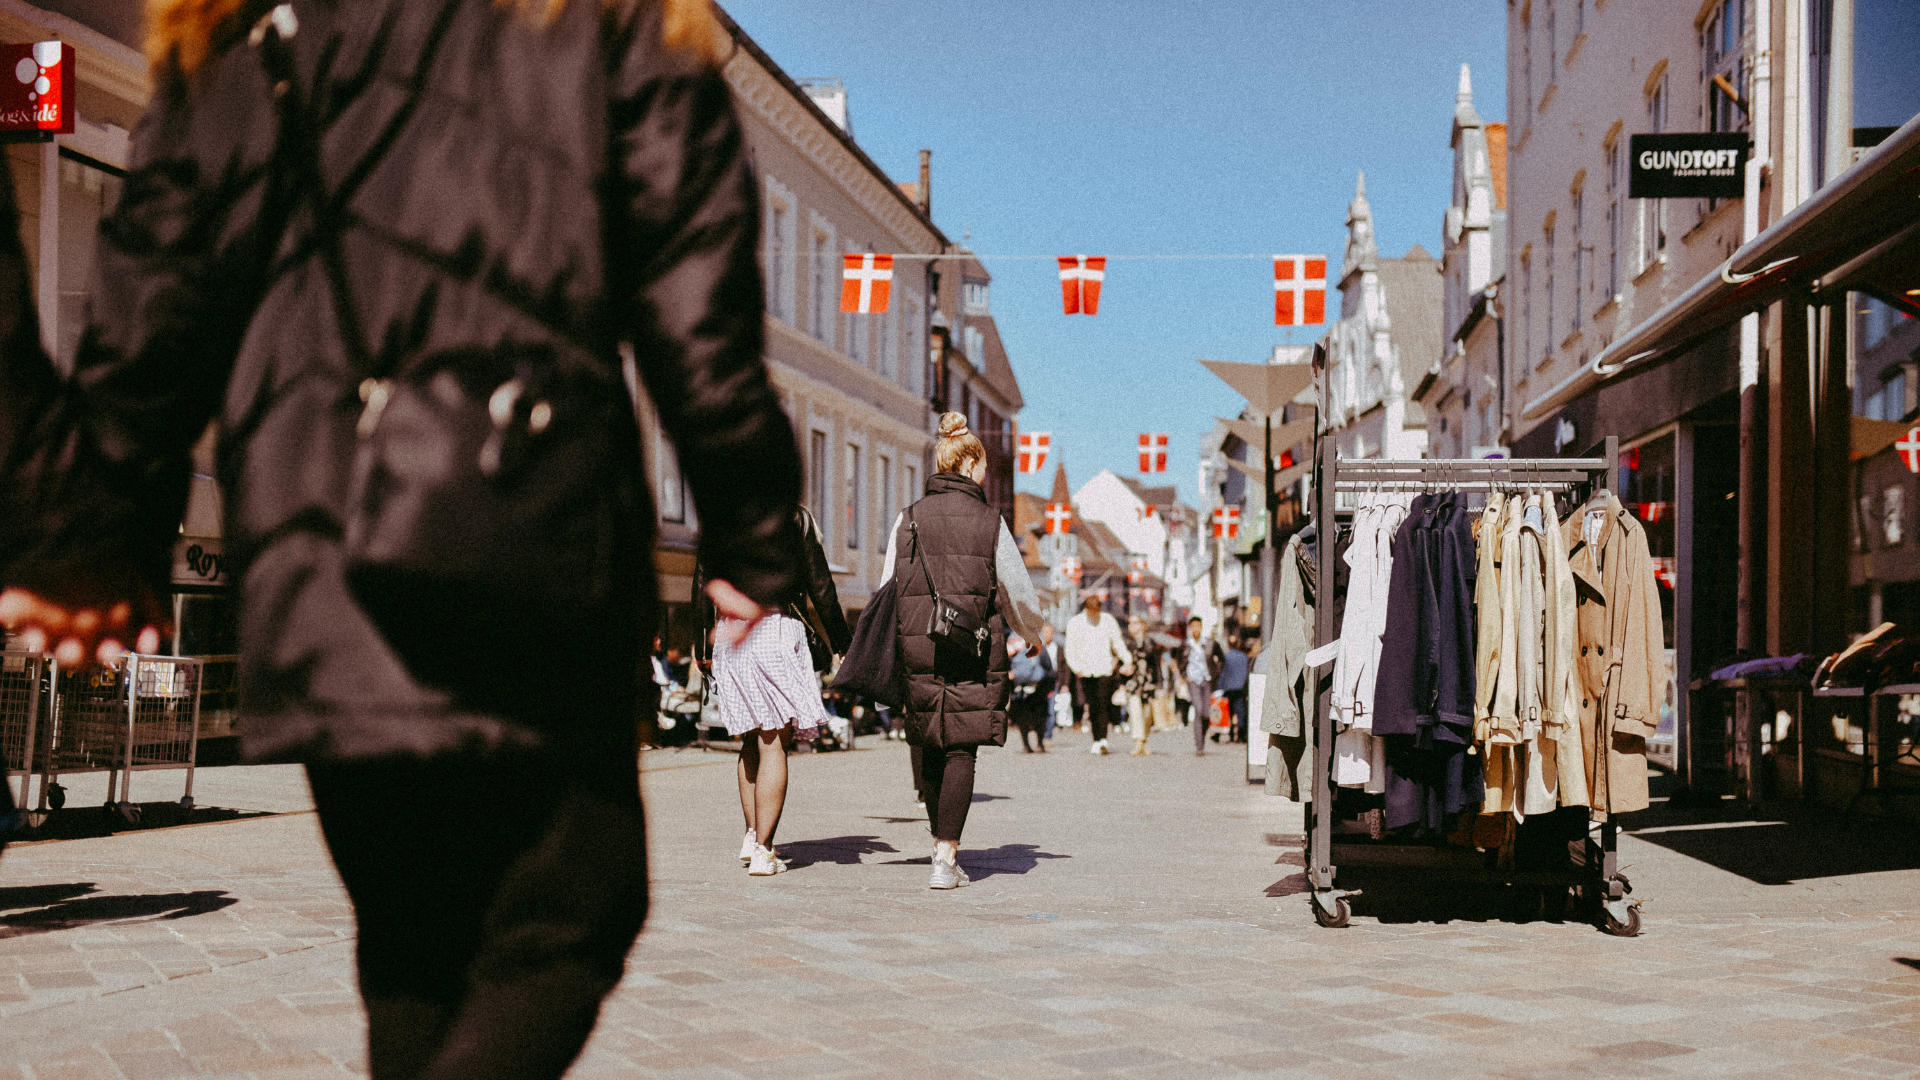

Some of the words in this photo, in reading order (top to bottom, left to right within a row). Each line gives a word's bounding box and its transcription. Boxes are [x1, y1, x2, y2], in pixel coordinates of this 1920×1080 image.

[0, 103, 57, 124] og&idé
[1639, 149, 1738, 169] GUNDTOFT
[1673, 168, 1708, 177] FASHION
[187, 544, 226, 582] Roy
